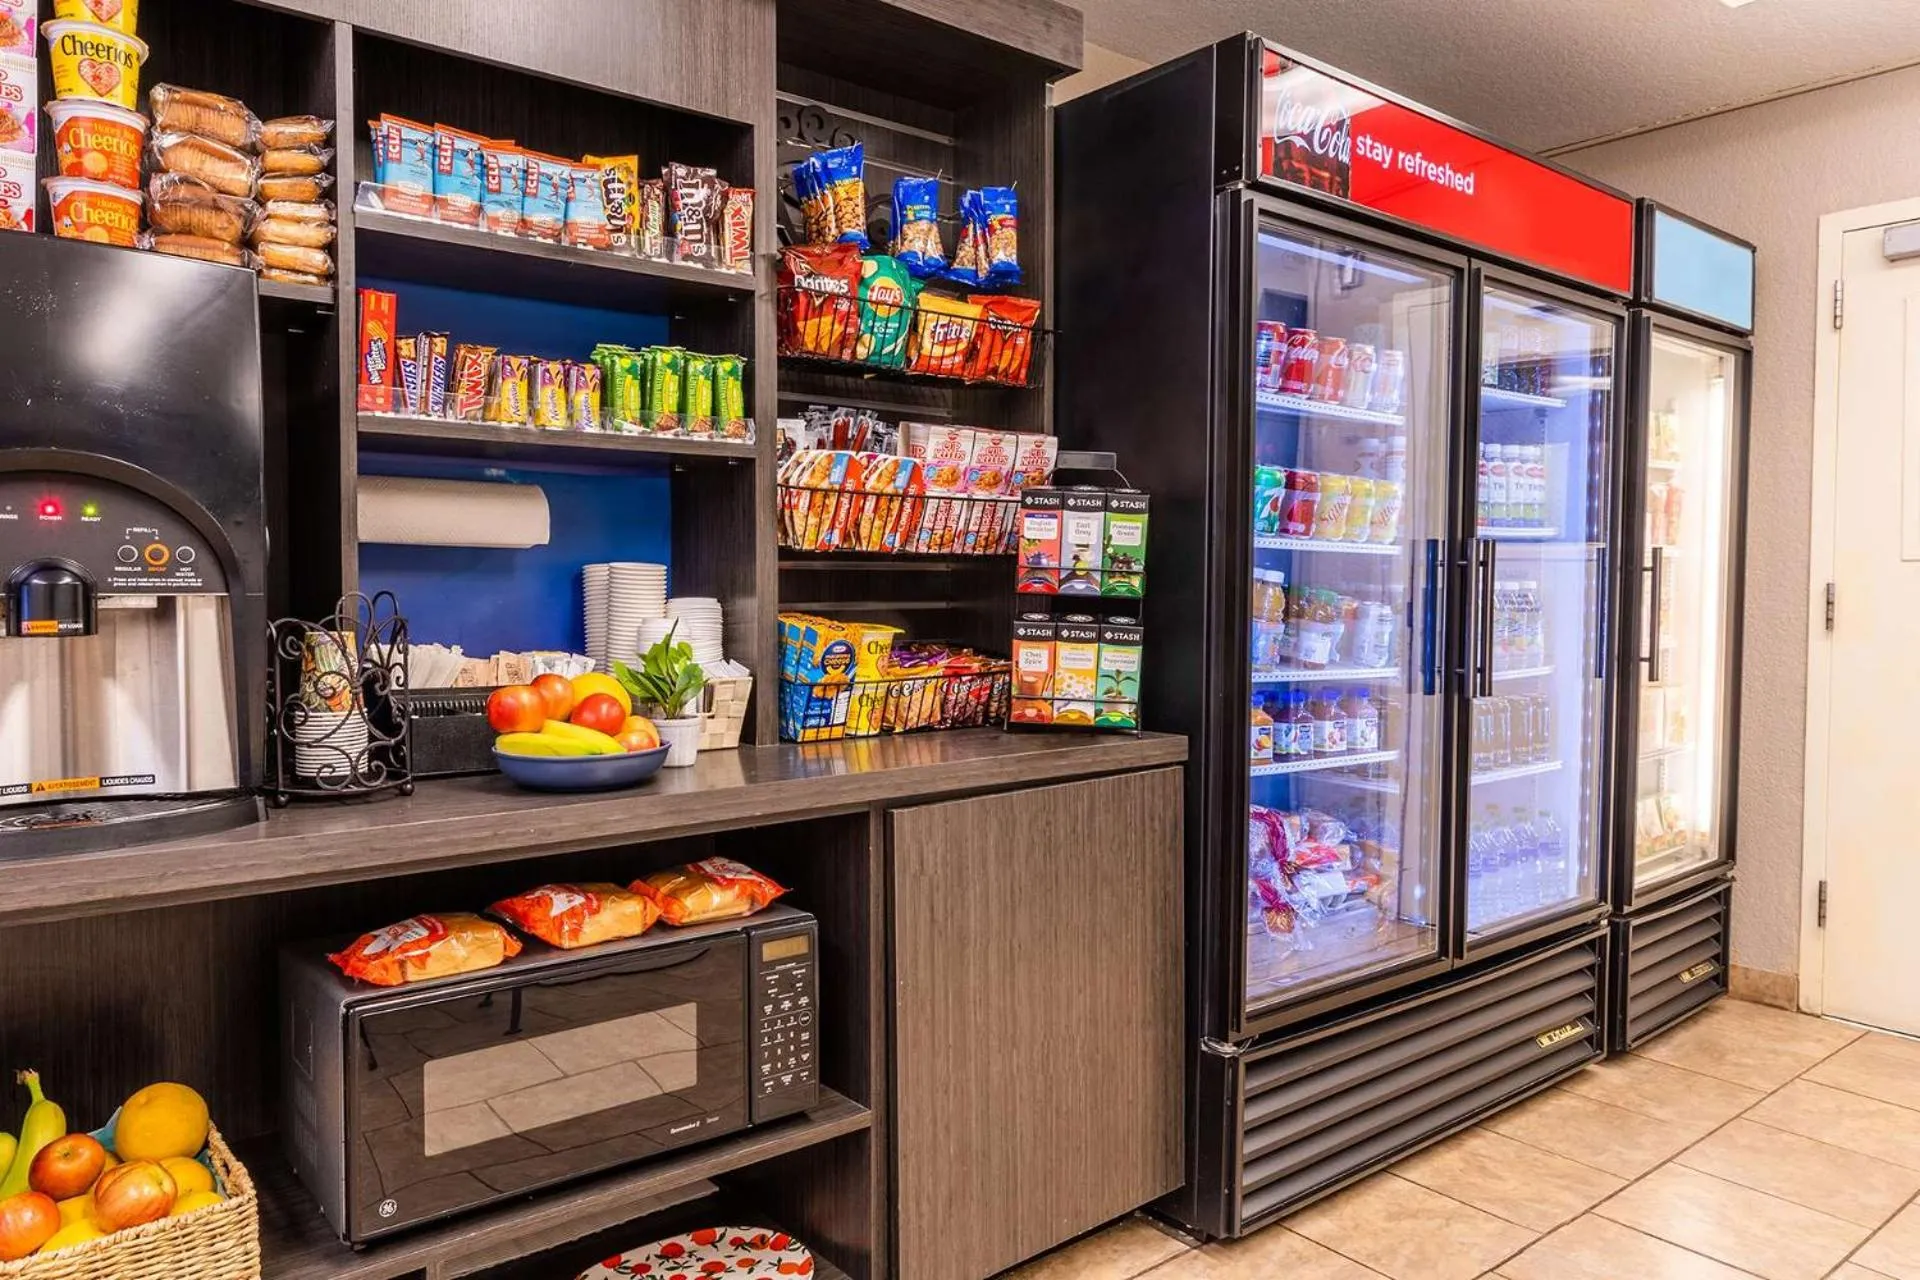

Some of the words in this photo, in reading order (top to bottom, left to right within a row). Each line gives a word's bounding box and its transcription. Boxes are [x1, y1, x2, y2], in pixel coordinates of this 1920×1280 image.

[61, 34, 133, 69] Cheerios
[69, 127, 138, 159] Cheerios
[388, 127, 401, 153] CLIF
[440, 135, 453, 164] CLIF
[488, 155, 499, 184] CLIF
[527, 160, 539, 188] CLIF
[1356, 135, 1392, 169] stay
[1397, 150, 1474, 195] refreshed
[69, 201, 137, 230] Cheerios
[795, 274, 849, 294] Doritos
[932, 322, 970, 342] Fritos
[431, 357, 446, 412] SNICKERS
[1034, 497, 1060, 505] STASH
[1076, 499, 1102, 507] STASH
[1119, 501, 1145, 509] STASH
[1027, 628, 1052, 636] STASH
